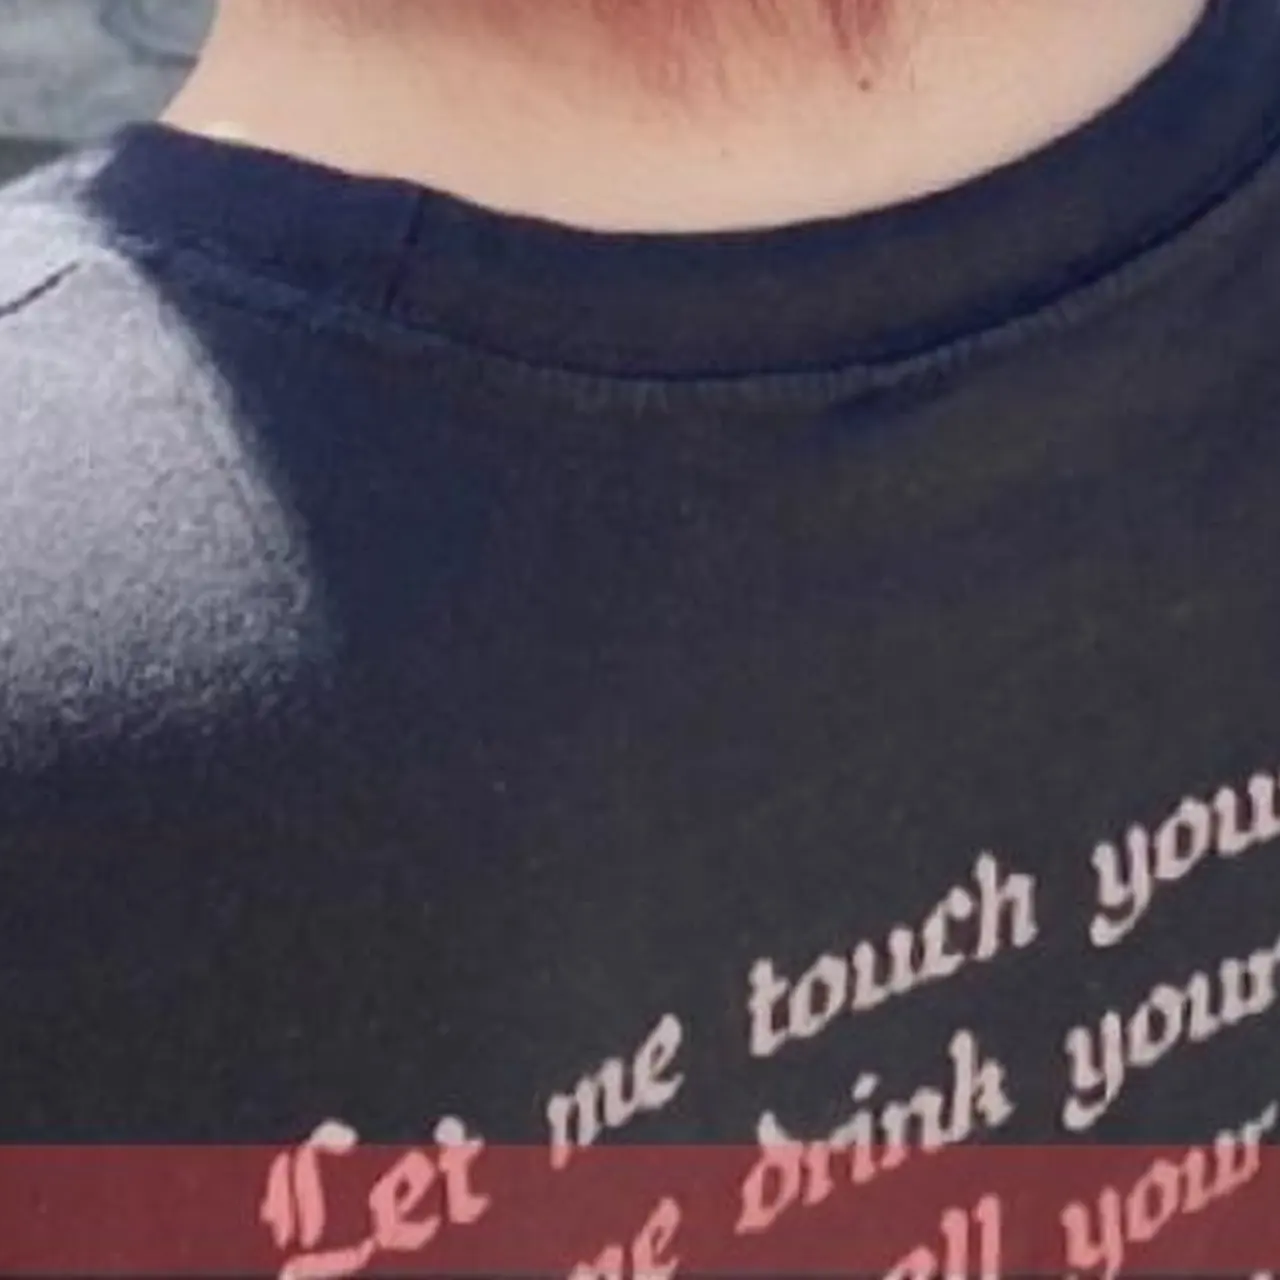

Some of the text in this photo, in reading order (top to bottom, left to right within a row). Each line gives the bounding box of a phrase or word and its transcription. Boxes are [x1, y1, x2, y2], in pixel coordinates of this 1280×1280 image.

[260, 1114, 492, 1280] Let
[546, 1013, 686, 1170] me
[748, 850, 1039, 1058] touch
[734, 1028, 1017, 1234] drink
[1059, 1100, 1279, 1280] your
